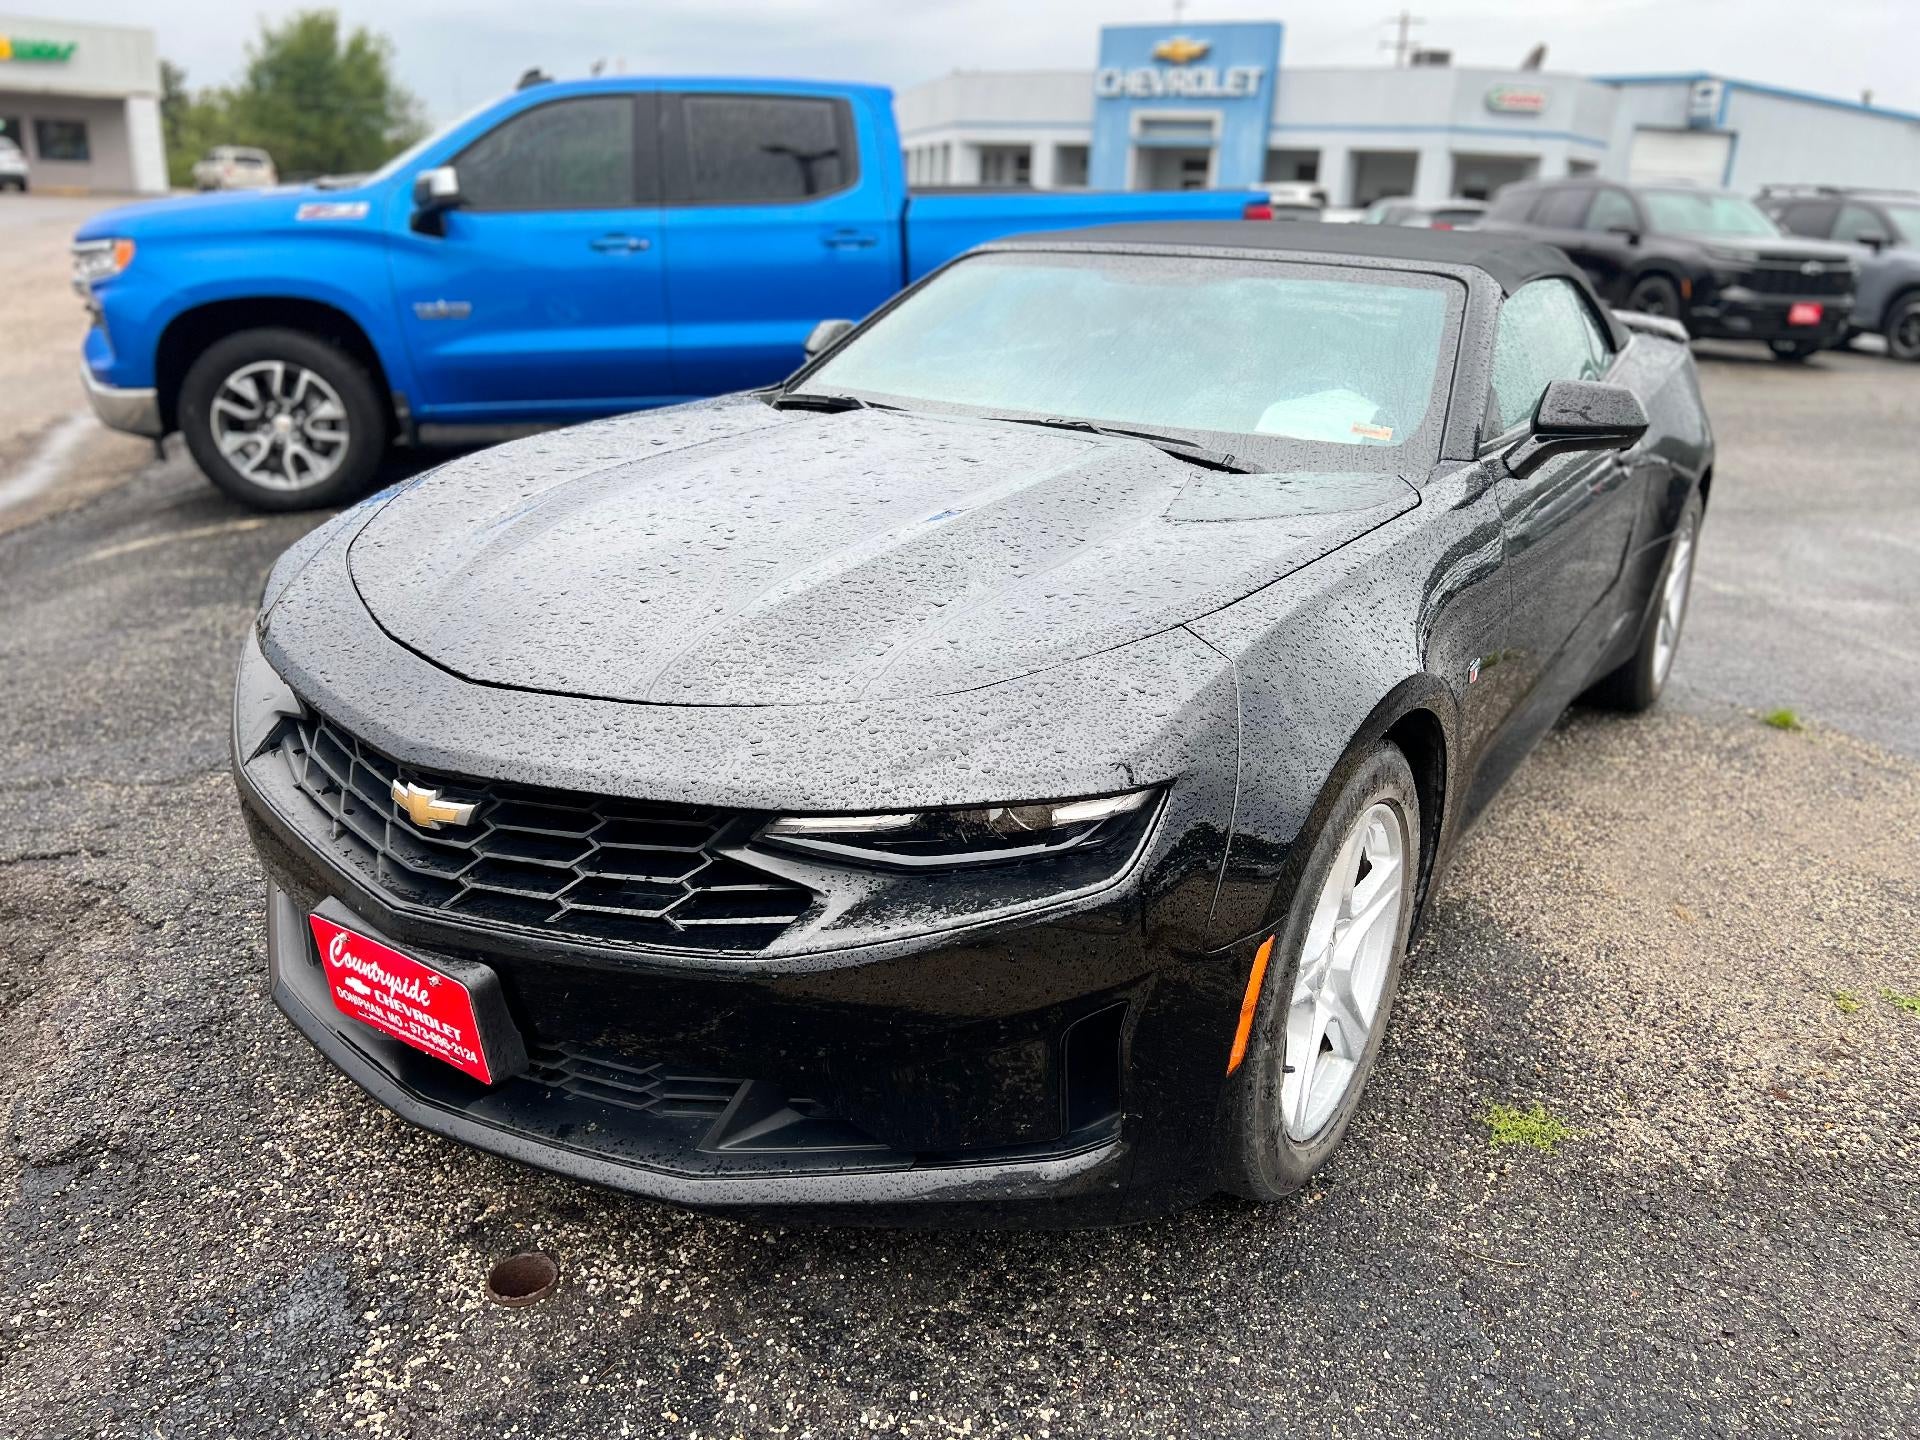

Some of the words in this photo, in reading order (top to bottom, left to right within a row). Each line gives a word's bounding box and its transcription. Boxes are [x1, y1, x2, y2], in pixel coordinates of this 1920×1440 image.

[1097, 67, 1263, 98] CHEVROLET
[329, 933, 431, 1007] Countryside
[374, 990, 461, 1041] CHEVROLET
